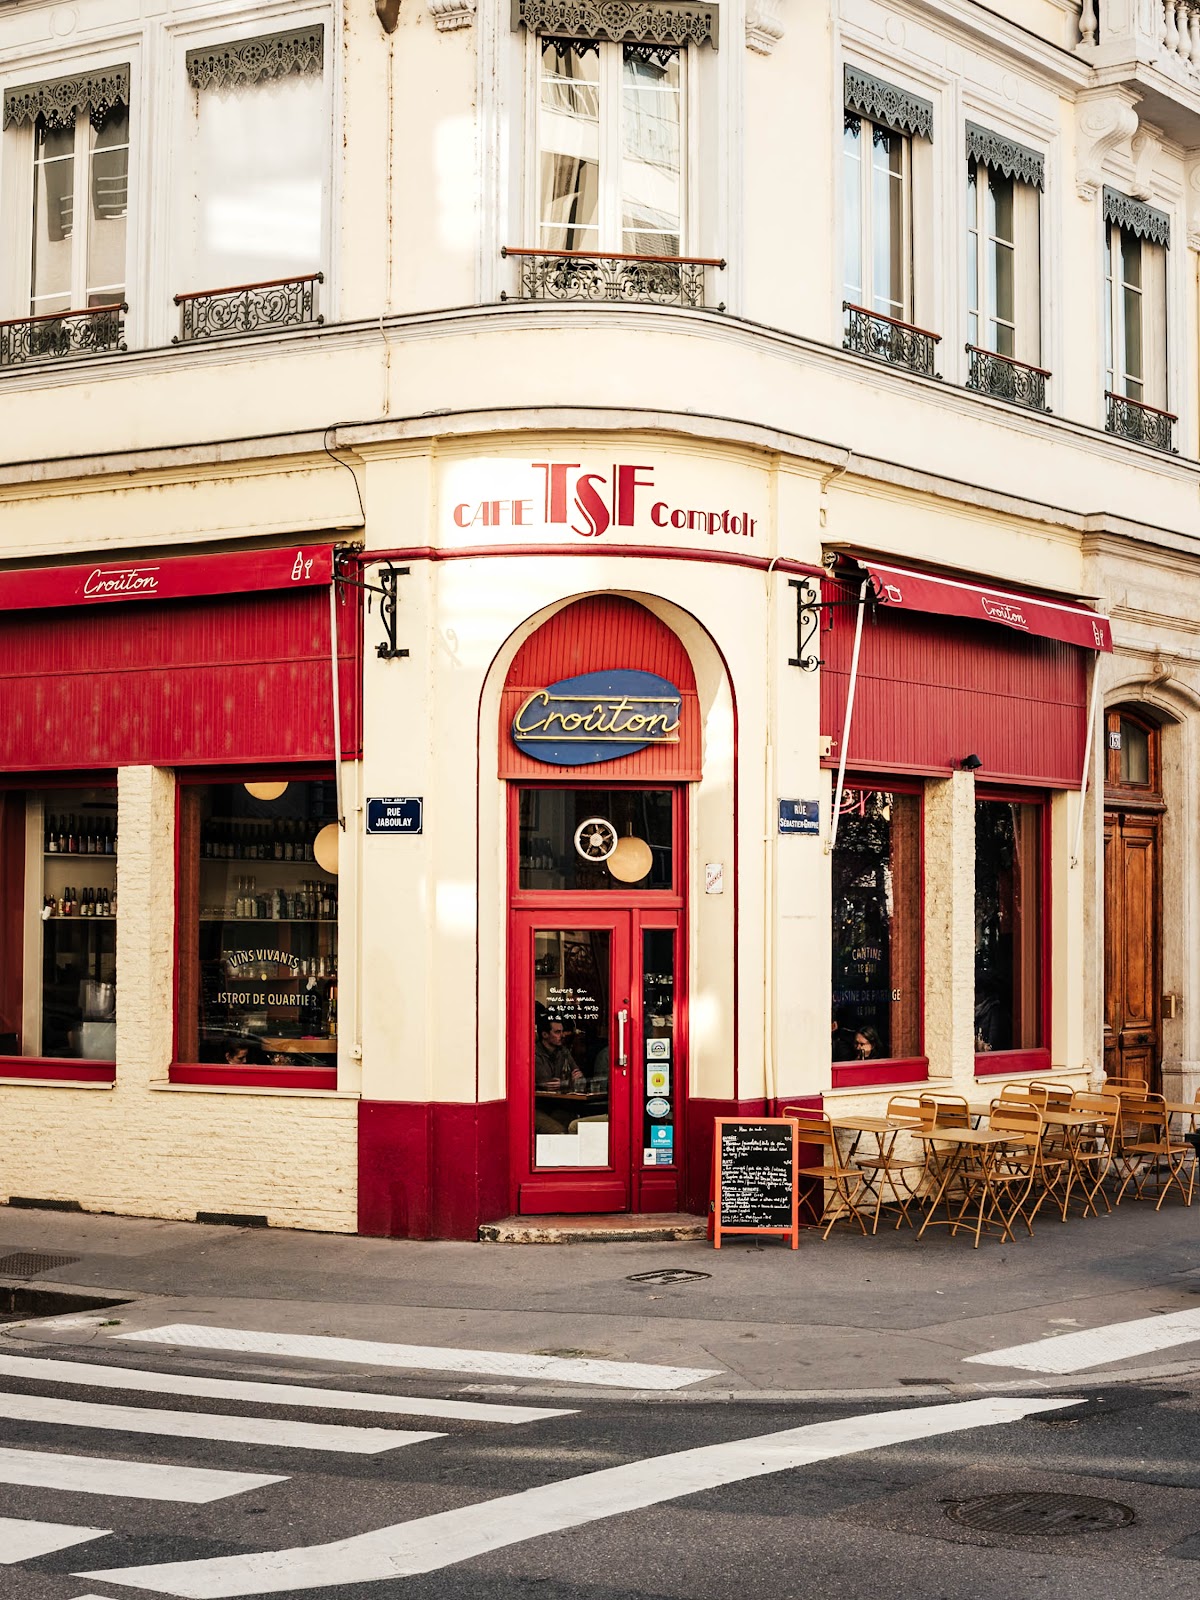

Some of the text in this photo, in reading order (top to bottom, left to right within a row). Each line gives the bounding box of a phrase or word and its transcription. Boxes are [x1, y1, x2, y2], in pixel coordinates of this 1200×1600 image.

[453, 500, 533, 528] CAFE
[532, 463, 654, 537] TSF
[515, 691, 681, 733] Croûton
[386, 807, 401, 816] RUE
[794, 804, 807, 815] RUE
[375, 818, 412, 827] JABOULAY
[229, 949, 300, 969] VINS VIVANTS
[851, 946, 882, 961] CANTINE
[212, 992, 317, 1006] ISTROT DE QUARTIER
